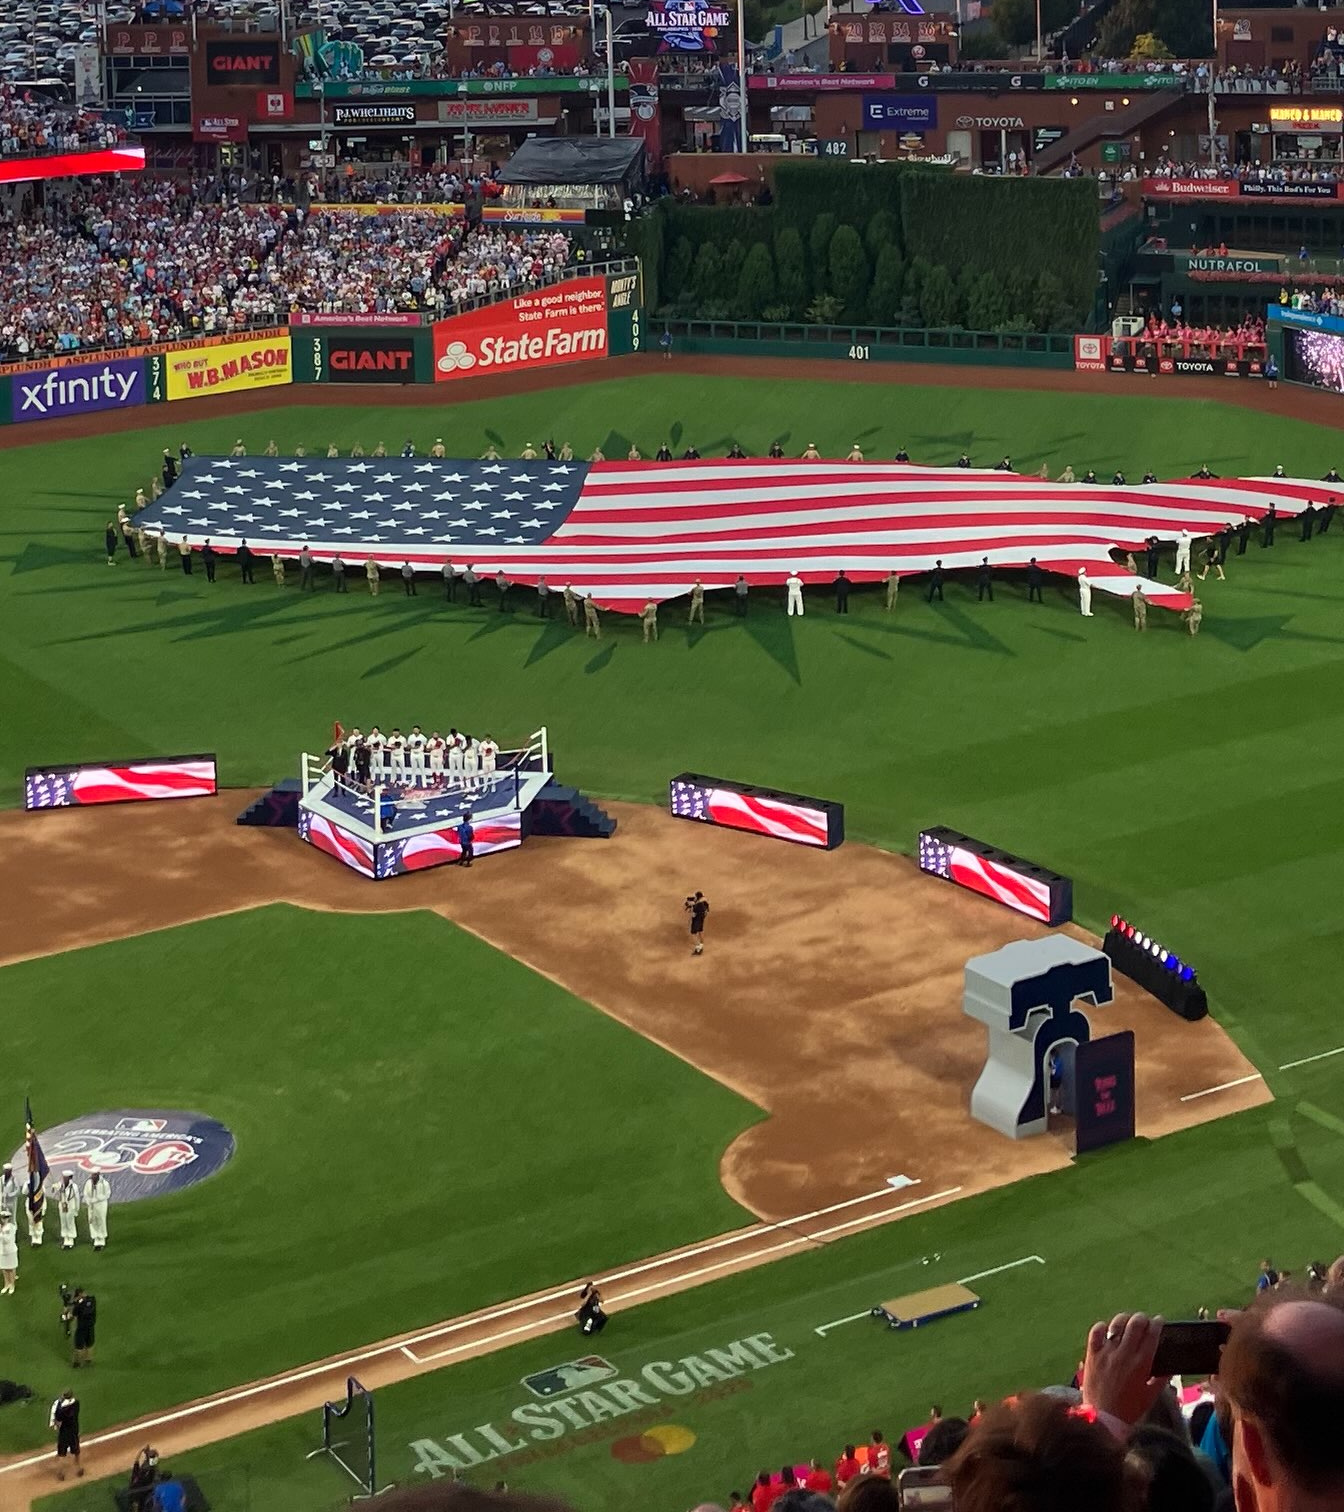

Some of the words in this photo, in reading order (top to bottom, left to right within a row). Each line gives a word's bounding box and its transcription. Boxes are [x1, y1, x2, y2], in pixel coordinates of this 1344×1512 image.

[645, 11, 668, 27] ALL
[668, 11, 697, 27] STAR
[698, 11, 730, 27] GAME
[847, 23, 863, 37] 20
[869, 22, 886, 37] 32
[893, 22, 910, 37] 34
[212, 56, 273, 70] GIANT
[493, 81, 518, 91] NFP
[779, 77, 820, 87] America's
[821, 77, 841, 87] Best
[842, 77, 875, 87] Network
[887, 106, 929, 118] Extreme
[976, 117, 1025, 128] TOYOTA
[825, 142, 847, 155] 482
[1172, 181, 1230, 194] Budweiser
[1267, 185, 1284, 194] This
[1304, 186, 1317, 194] For
[1318, 186, 1332, 195] You
[1188, 259, 1263, 273] NUTRAFOL
[610, 275, 637, 294] MONTY'S
[513, 298, 532, 310] Like
[534, 299, 540, 308] a
[541, 295, 563, 307] good
[612, 291, 632, 308] ANGLE
[314, 314, 354, 324] America's
[355, 314, 372, 324] Best
[373, 314, 408, 324] Network
[518, 311, 543, 322] State
[544, 308, 568, 320] Farm
[569, 307, 577, 316] is
[221, 328, 282, 345] ASPLUNDH
[143, 339, 206, 355] ASPLUNDH
[848, 345, 870, 361] 401
[65, 349, 131, 367] ASPLUNDH
[313, 338, 322, 381] 387
[329, 351, 413, 370] GIANT
[1075, 362, 1106, 371] TOYOTA
[1176, 361, 1214, 373] TOYOTA
[152, 357, 161, 401] 374
[21, 366, 138, 413] xfinity
[64, 1128, 141, 1139] CELEBRATING
[142, 1129, 204, 1145] AMERICA'S
[409, 1423, 529, 1479] ALL
[511, 1378, 661, 1440] STAR
[641, 1331, 796, 1396] GAME
